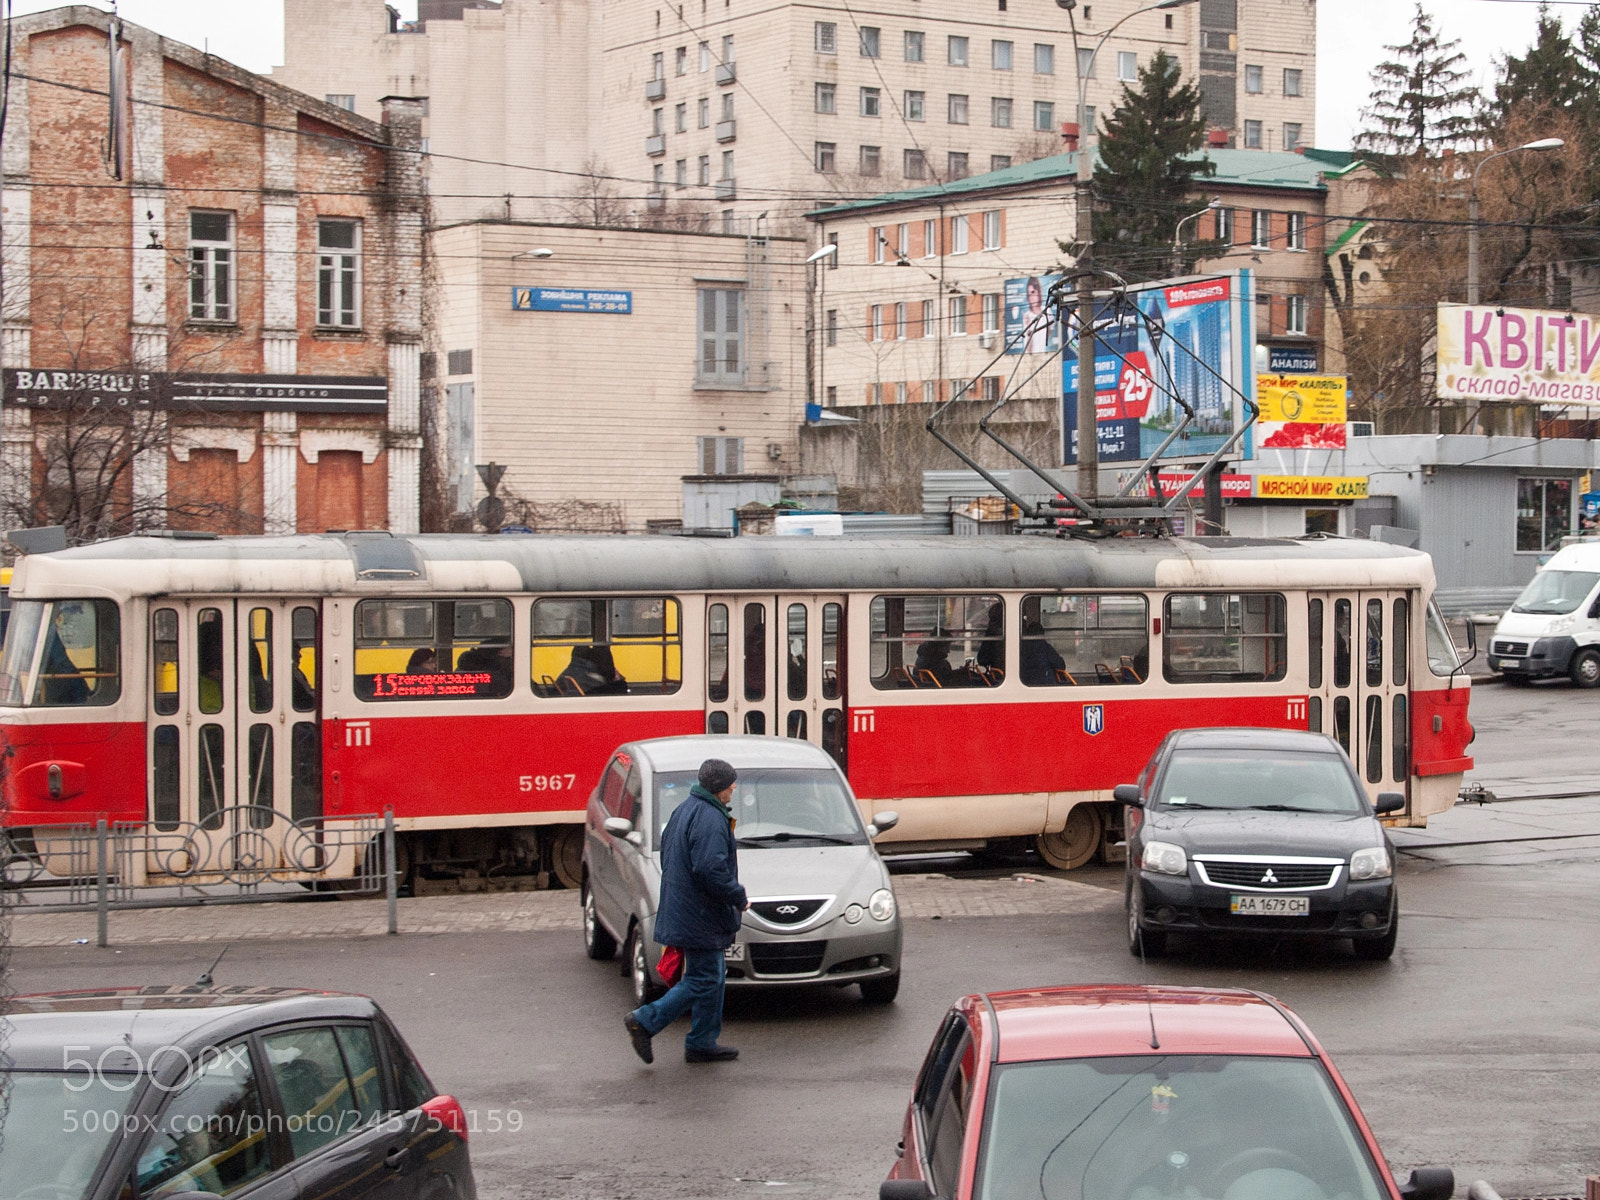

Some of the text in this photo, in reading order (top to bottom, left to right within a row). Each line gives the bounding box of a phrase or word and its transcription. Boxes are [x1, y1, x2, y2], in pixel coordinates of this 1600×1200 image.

[1271, 358, 1317, 369] АНАЛІЗИ
[1124, 368, 1148, 402] 25
[1456, 374, 1600, 401] склад-магаз
[1261, 479, 1309, 495] МЯСНОЙ
[1311, 482, 1333, 496] МИР
[519, 774, 576, 792] 5967
[1239, 898, 1306, 911] AA 1679 CH
